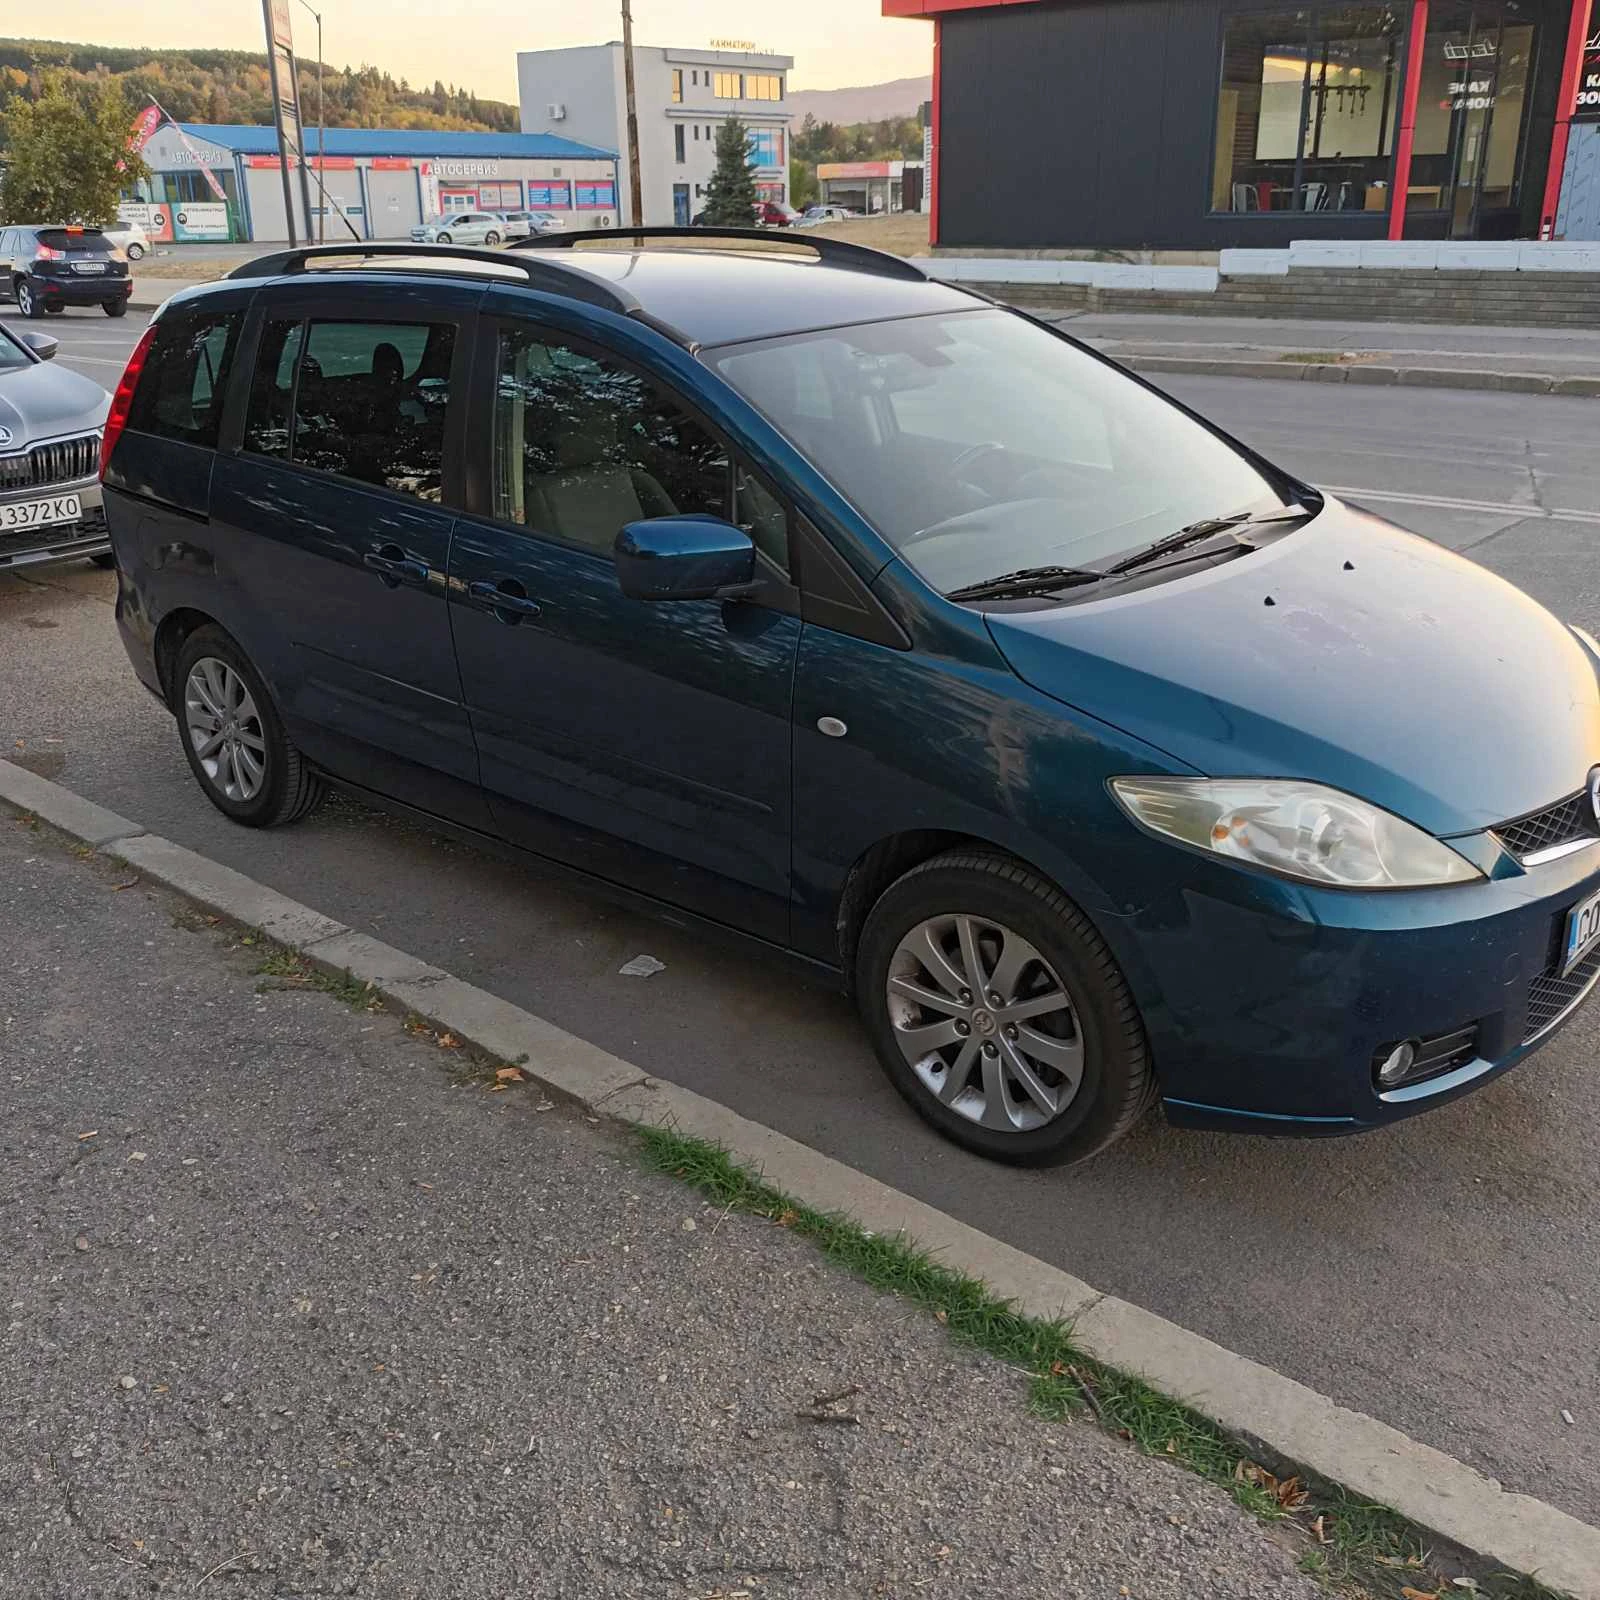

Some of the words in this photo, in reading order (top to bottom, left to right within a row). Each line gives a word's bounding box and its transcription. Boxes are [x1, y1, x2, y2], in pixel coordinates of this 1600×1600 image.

[1576, 91, 1600, 105] ЗО
[426, 163, 498, 176] АВТОСЕРВИЗ
[0, 498, 78, 526] 3372KO
